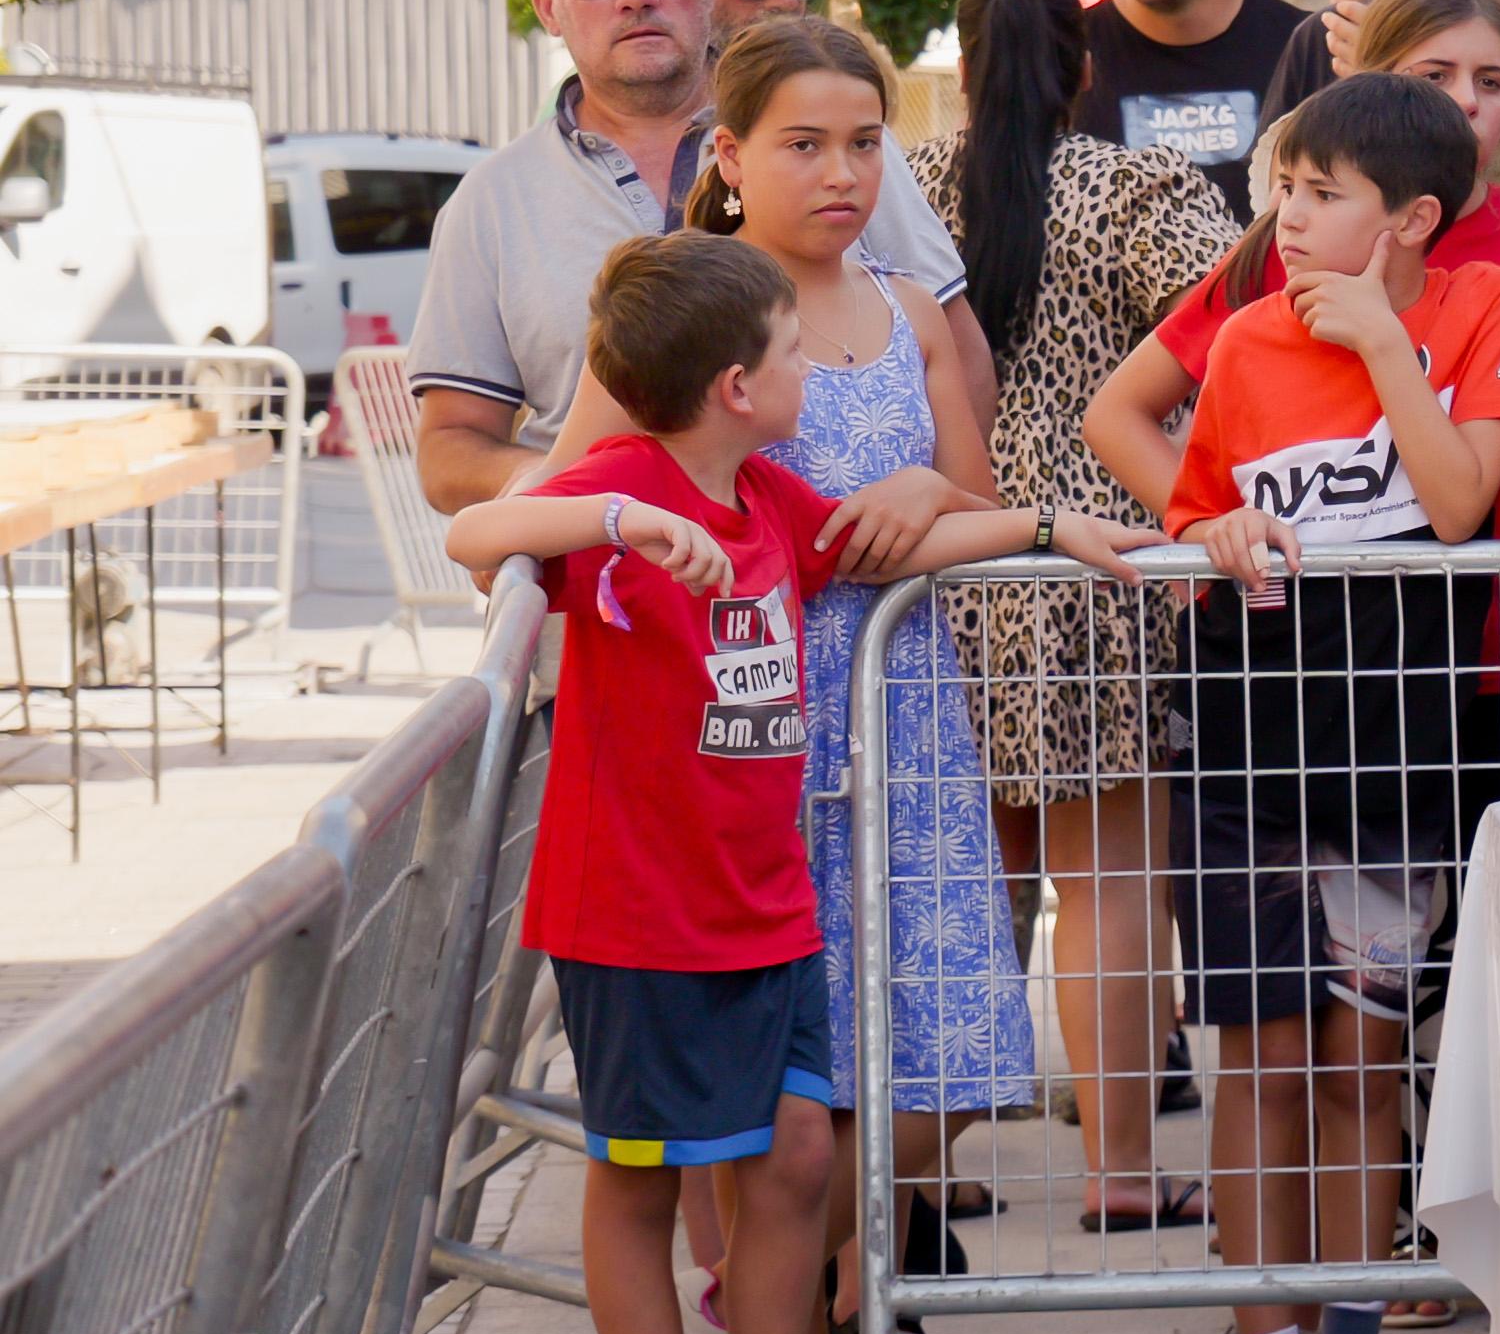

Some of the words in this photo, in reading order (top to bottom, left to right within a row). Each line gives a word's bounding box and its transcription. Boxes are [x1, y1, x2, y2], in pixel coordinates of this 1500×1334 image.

[1145, 105, 1236, 128] JACK&
[1339, 511, 1368, 523] Space
[727, 610, 751, 641] IX
[705, 717, 760, 748] BM.
